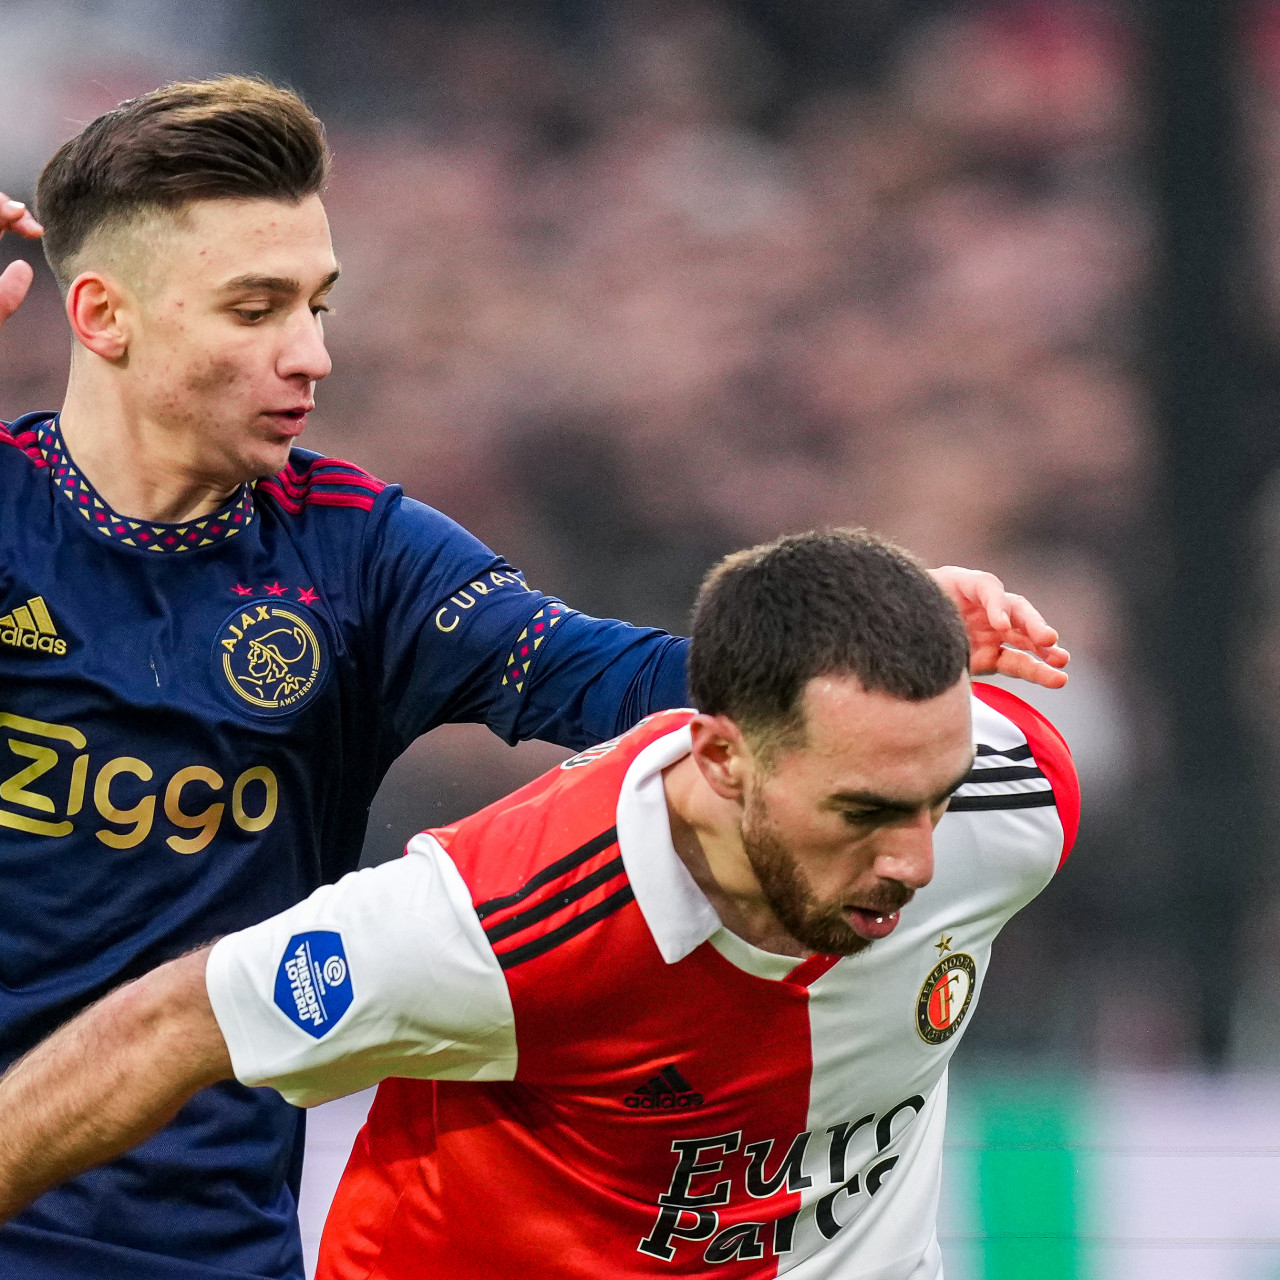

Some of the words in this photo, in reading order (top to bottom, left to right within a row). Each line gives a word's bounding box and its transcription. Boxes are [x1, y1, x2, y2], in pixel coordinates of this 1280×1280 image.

[221, 605, 271, 653] AJAX
[435, 570, 530, 633] CURA
[279, 669, 319, 707] AMSTERDAM
[294, 942, 324, 1027] VRIENDEN
[623, 1092, 704, 1110] adidas
[657, 1094, 926, 1209] Euro
